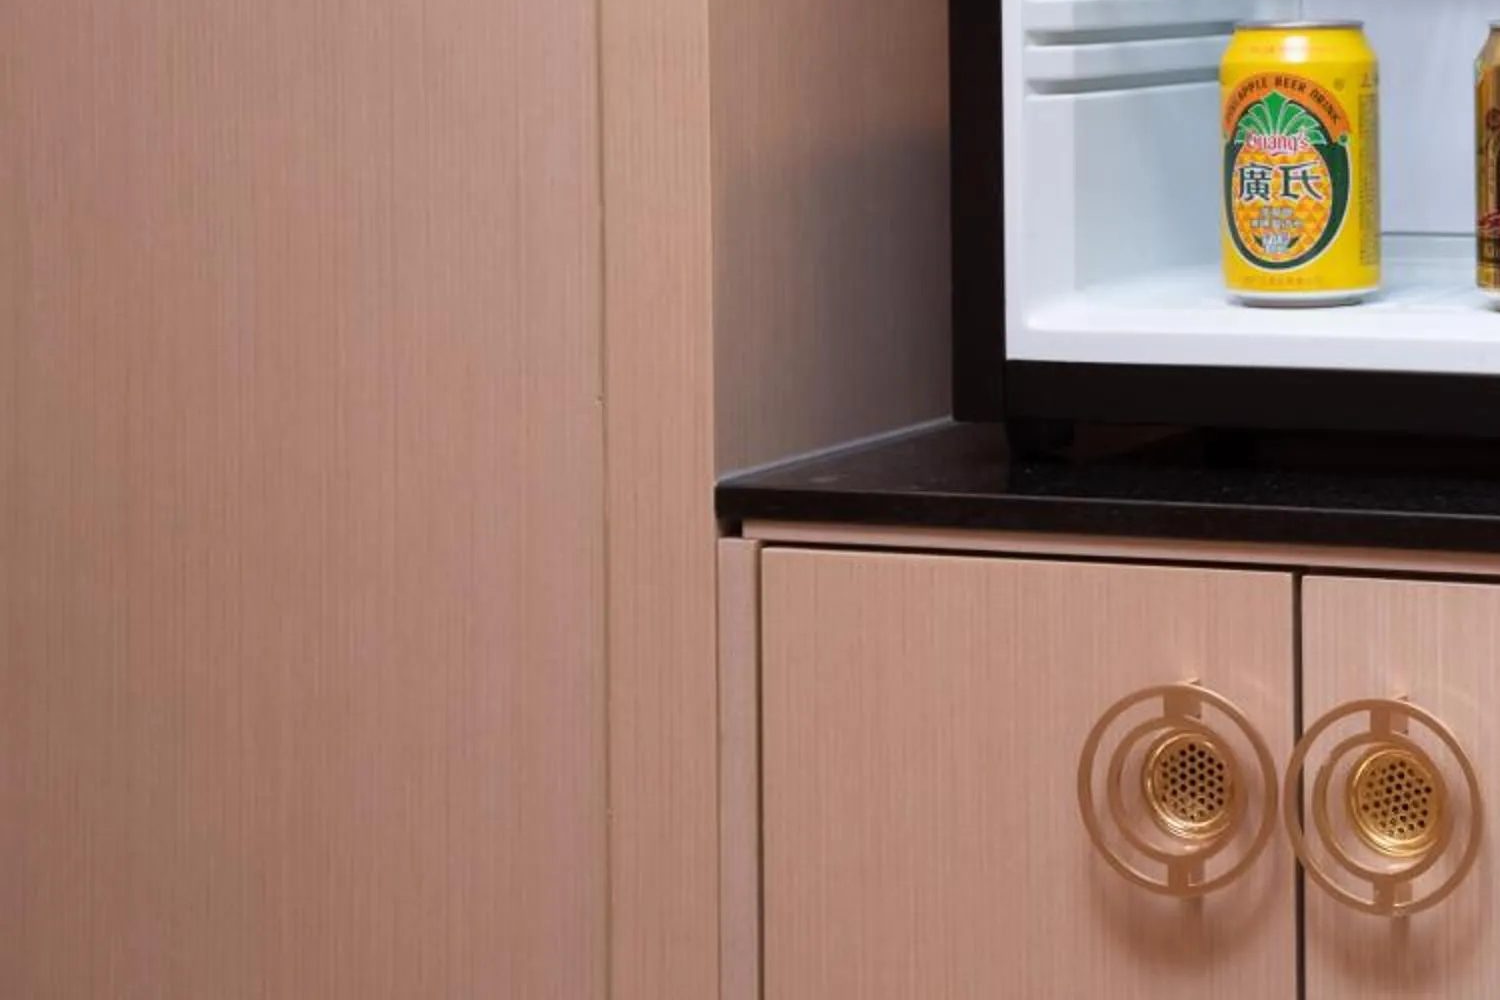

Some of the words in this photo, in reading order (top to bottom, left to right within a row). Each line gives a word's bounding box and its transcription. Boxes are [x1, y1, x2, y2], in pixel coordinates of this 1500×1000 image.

[1274, 76, 1307, 92] BEER
[1310, 87, 1341, 126] DRINK
[1239, 161, 1323, 201] 廣氏
